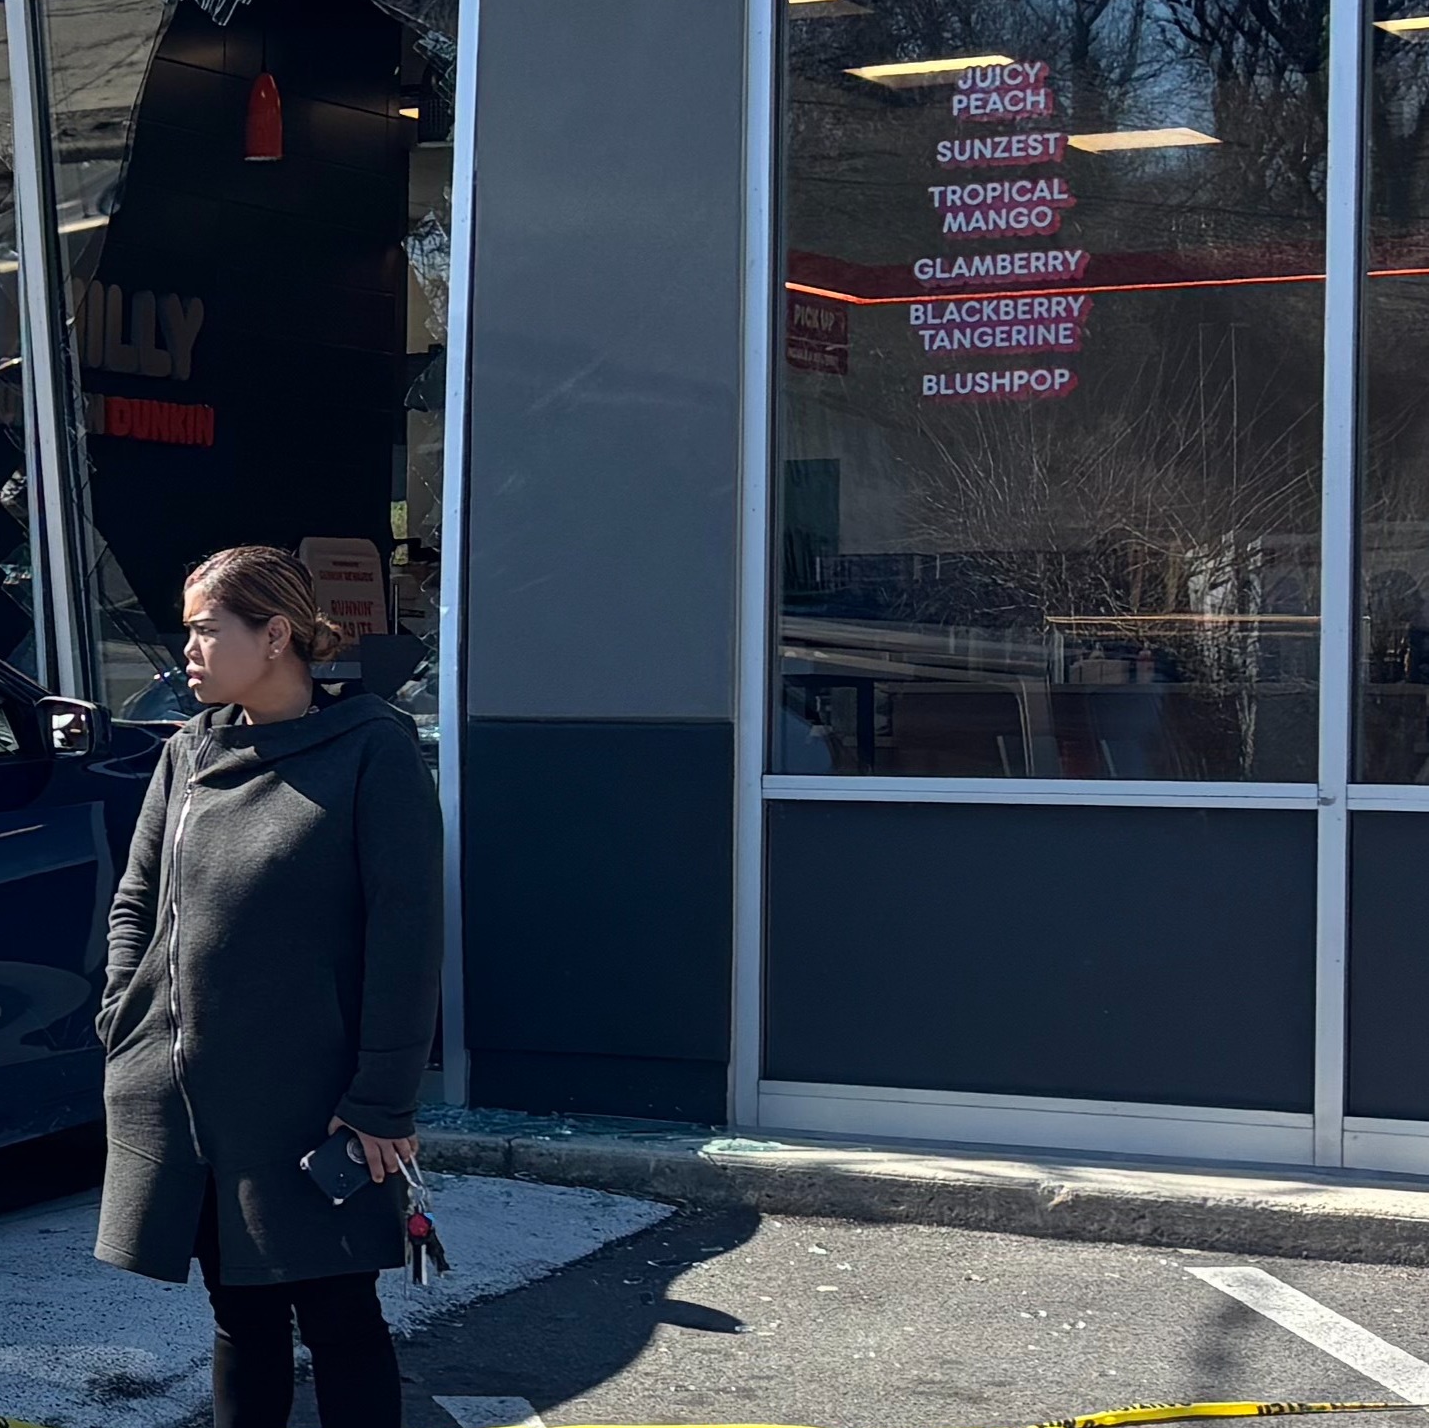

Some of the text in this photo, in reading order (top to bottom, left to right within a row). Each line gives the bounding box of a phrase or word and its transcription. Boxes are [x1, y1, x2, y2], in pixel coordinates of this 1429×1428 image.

[957, 61, 1042, 90] JUICY
[952, 88, 1046, 116] PEACH
[936, 132, 1061, 162] SUNZEST
[928, 178, 1069, 208] TROPICAL
[942, 205, 1053, 234] MANGO
[914, 249, 1083, 280] GLAMBERRY
[909, 295, 1085, 326] BLACKBERRY
[919, 323, 1074, 351] TANGERINE
[922, 368, 1071, 396] BLUSHPOP
